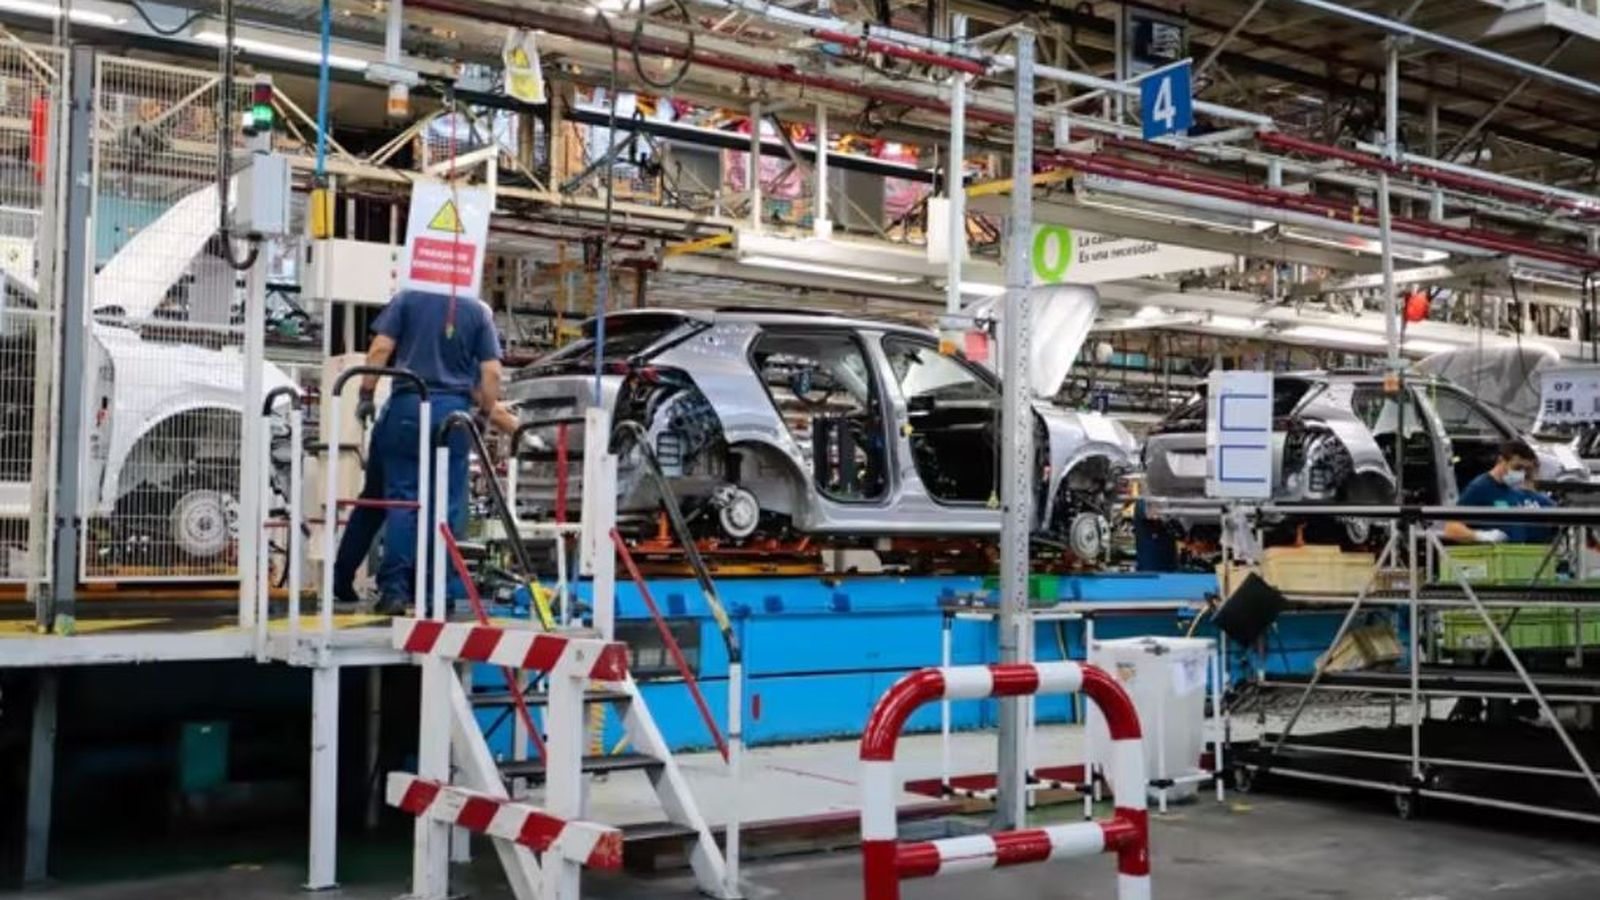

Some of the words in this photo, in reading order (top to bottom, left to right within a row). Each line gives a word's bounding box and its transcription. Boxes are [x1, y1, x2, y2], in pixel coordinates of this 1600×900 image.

[1153, 76, 1177, 129] 4
[1079, 251, 1089, 263] Es
[1091, 250, 1108, 261] una
